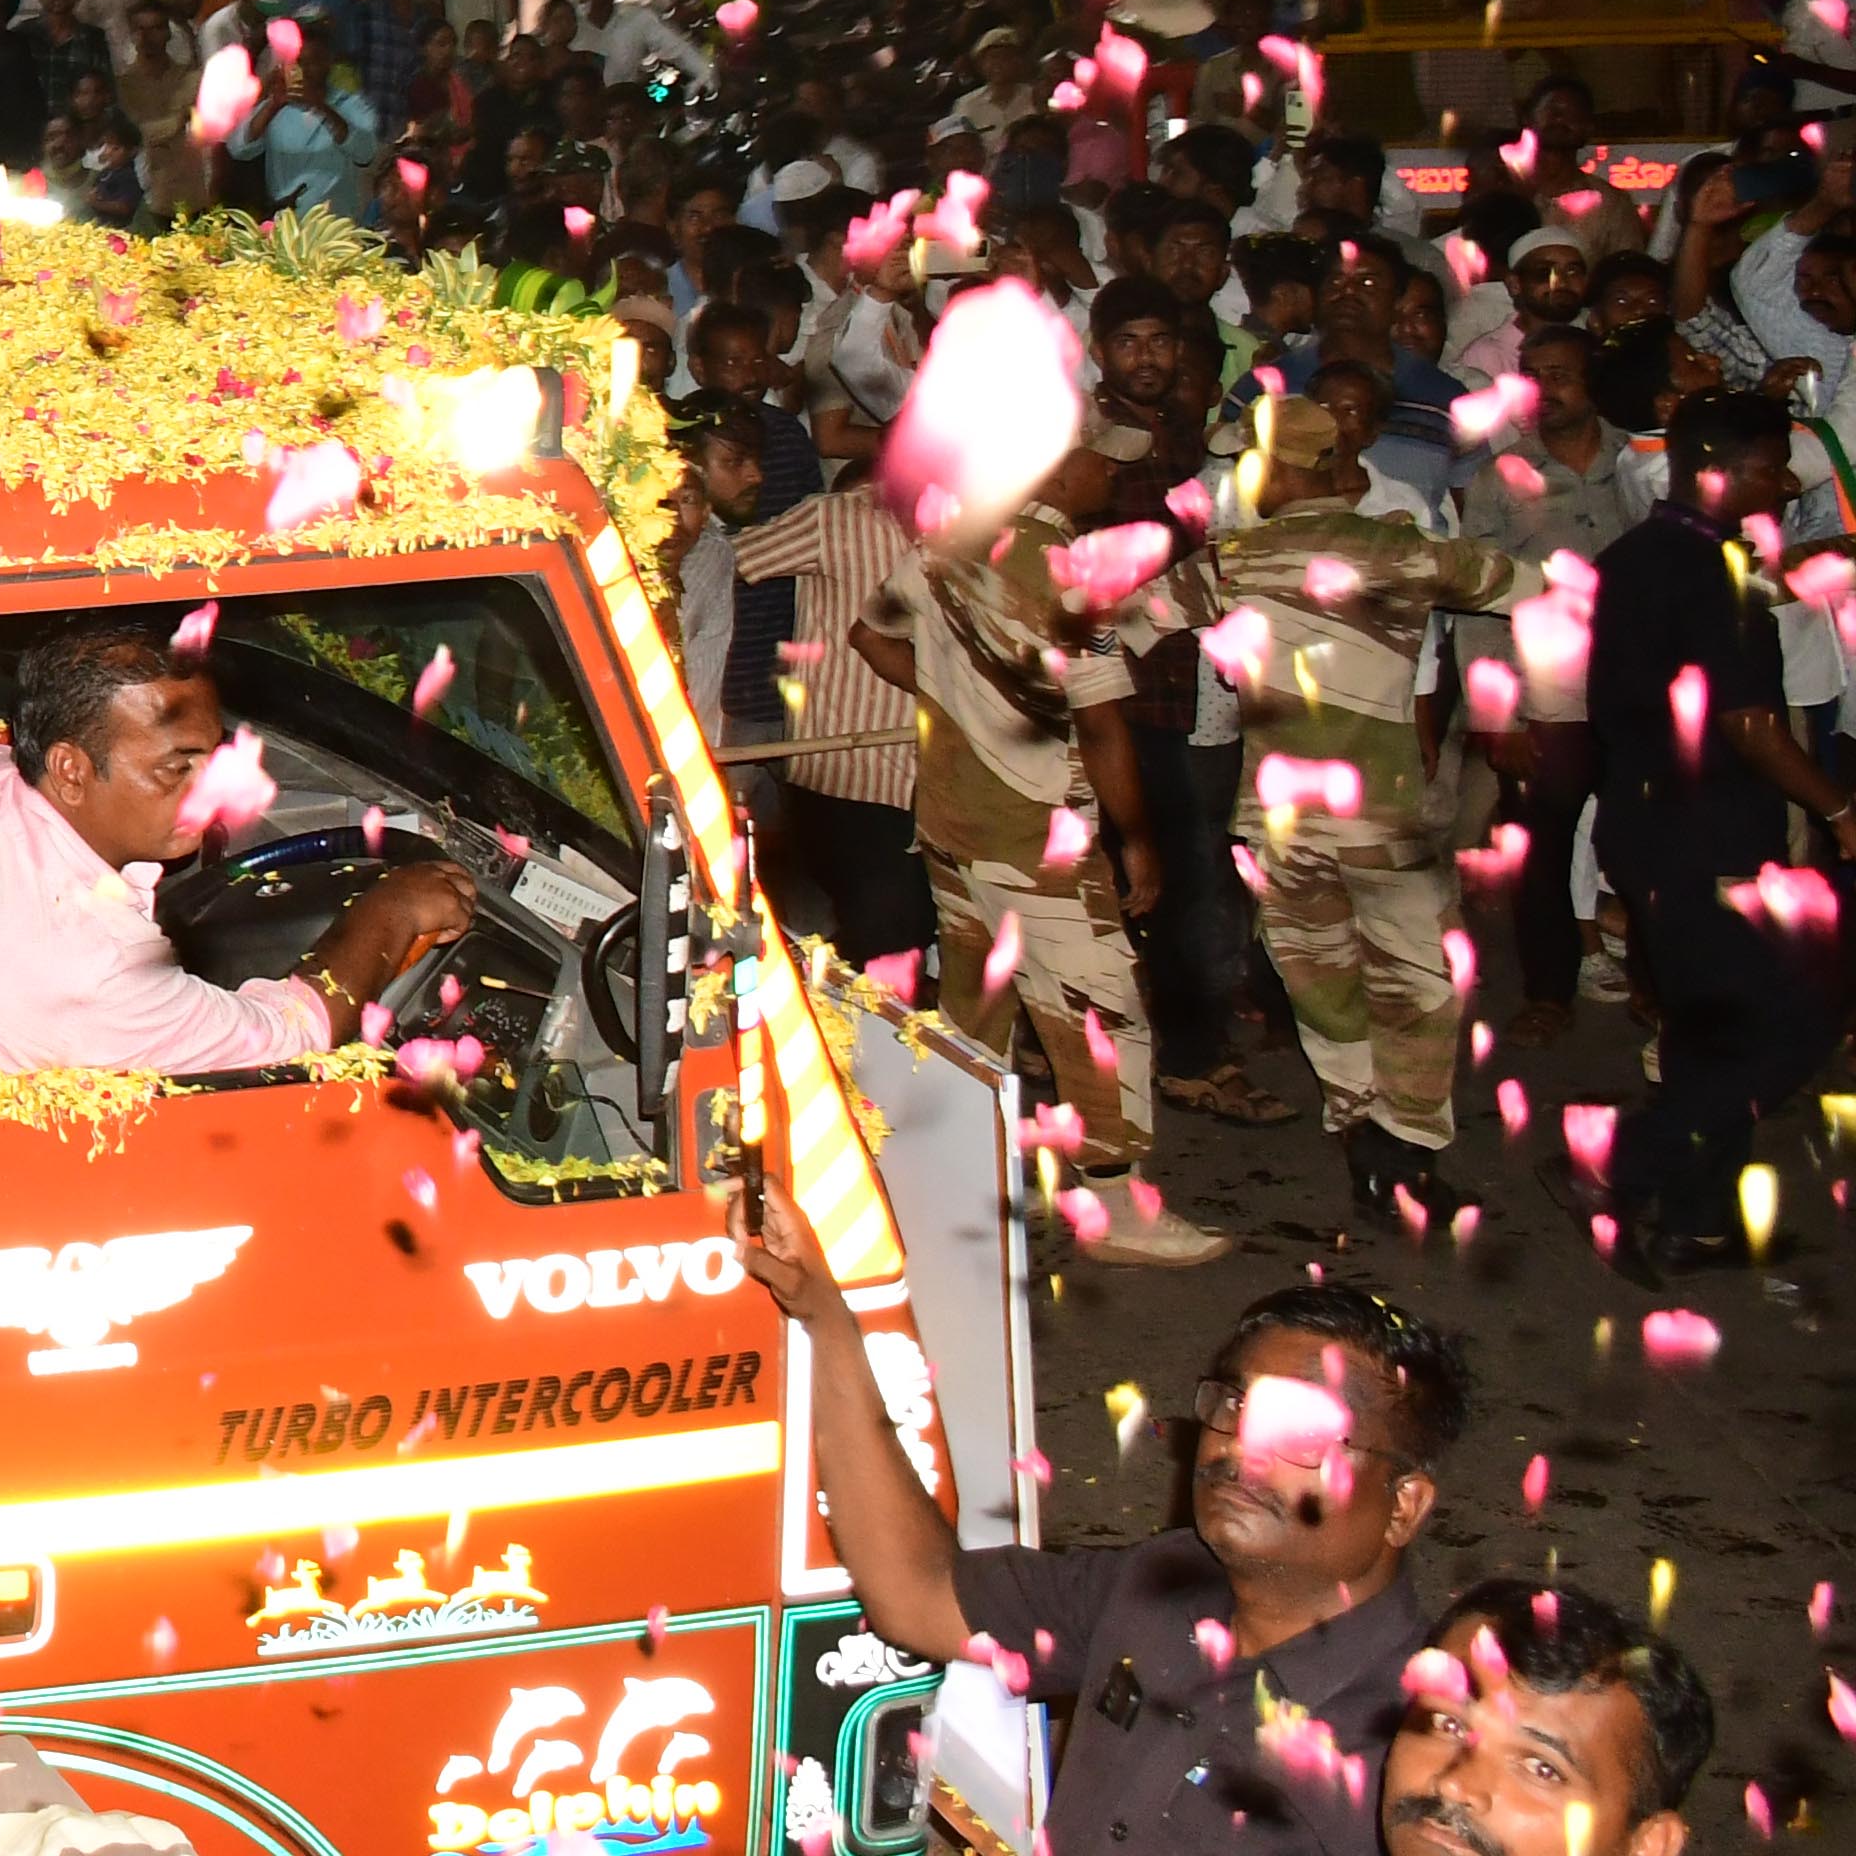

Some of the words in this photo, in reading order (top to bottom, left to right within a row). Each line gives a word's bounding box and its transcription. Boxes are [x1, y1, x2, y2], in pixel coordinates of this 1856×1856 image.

[463, 1235, 746, 1320] VOLVO
[214, 1394, 393, 1466] TURBO
[409, 1350, 763, 1443] INTERCOOLER
[428, 1774, 721, 1850] Dolphin
